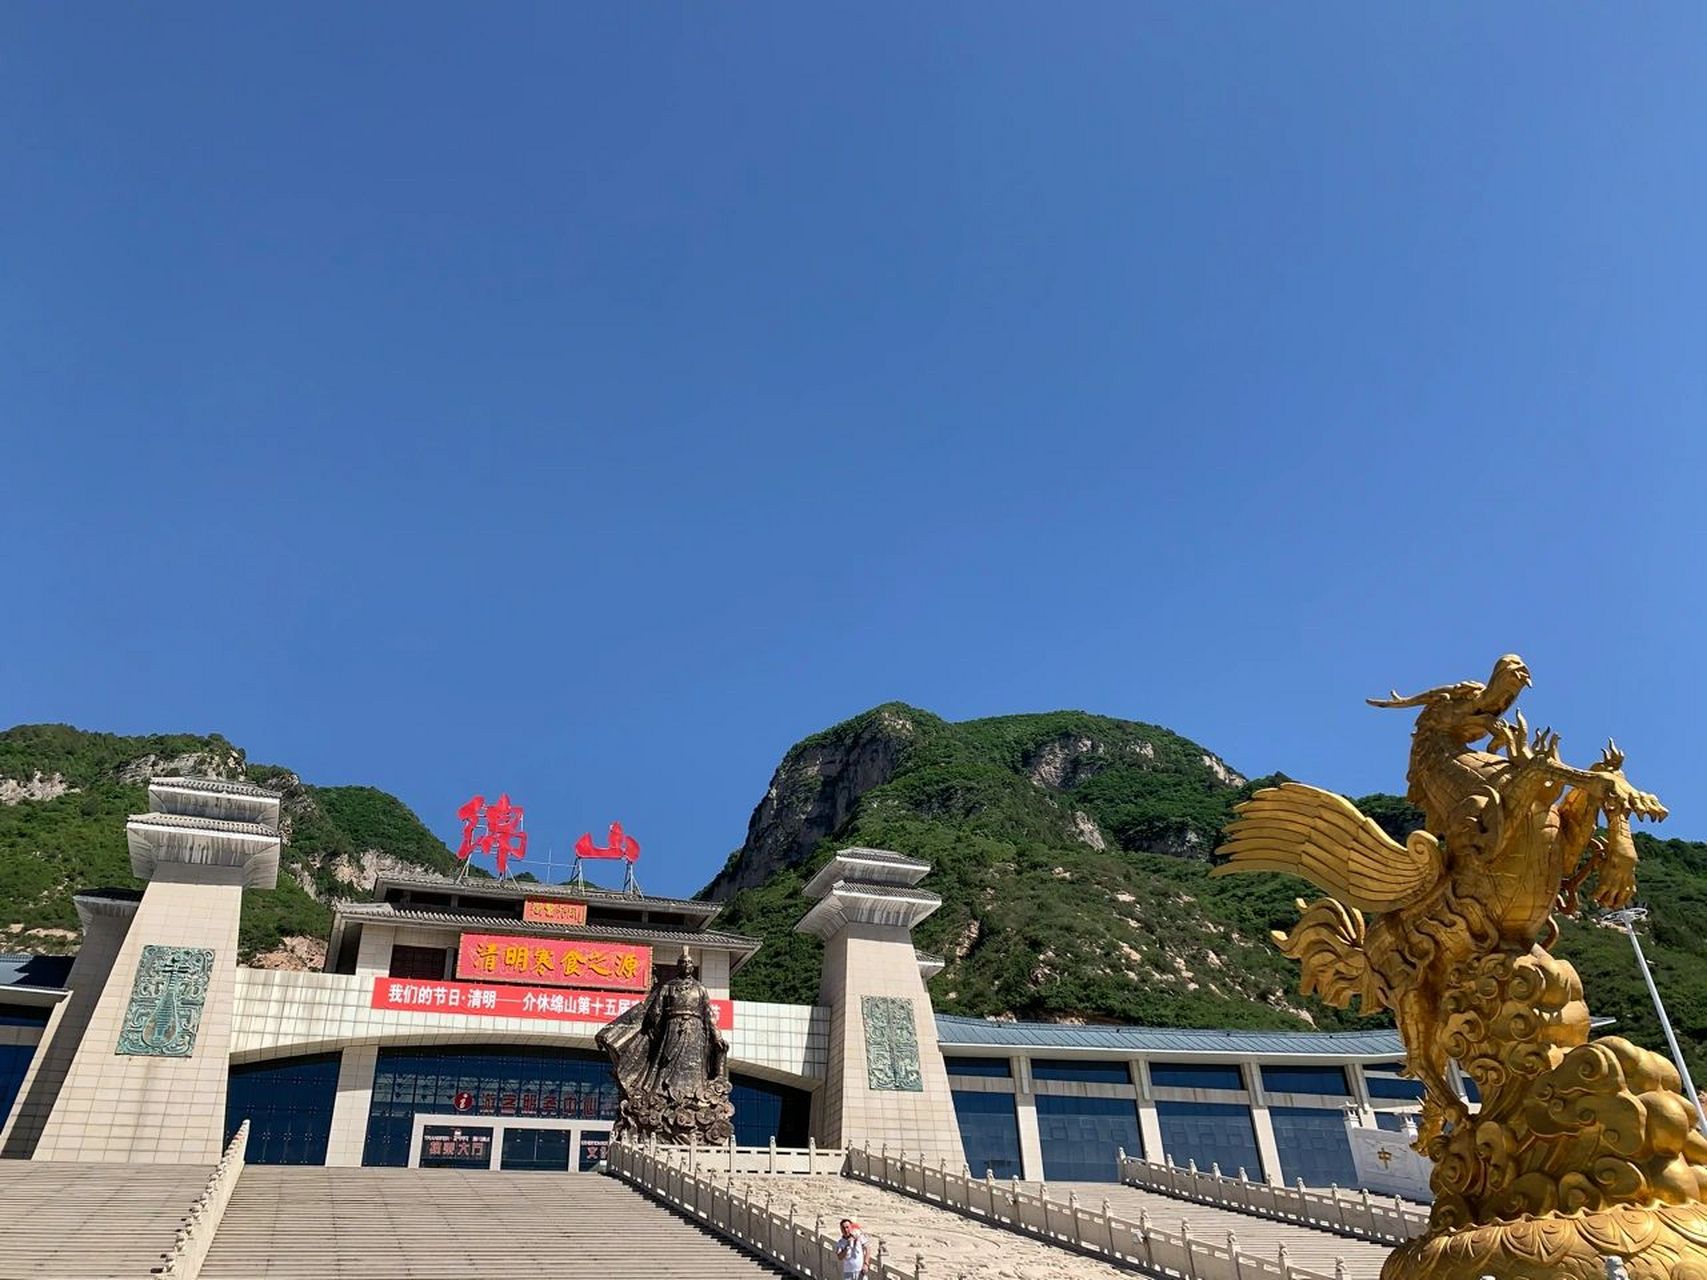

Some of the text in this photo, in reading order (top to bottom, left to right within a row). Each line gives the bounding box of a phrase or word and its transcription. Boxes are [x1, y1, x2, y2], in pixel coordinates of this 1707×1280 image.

[457, 794, 640, 873] 绵山
[473, 943, 640, 979] 清明寒食之源
